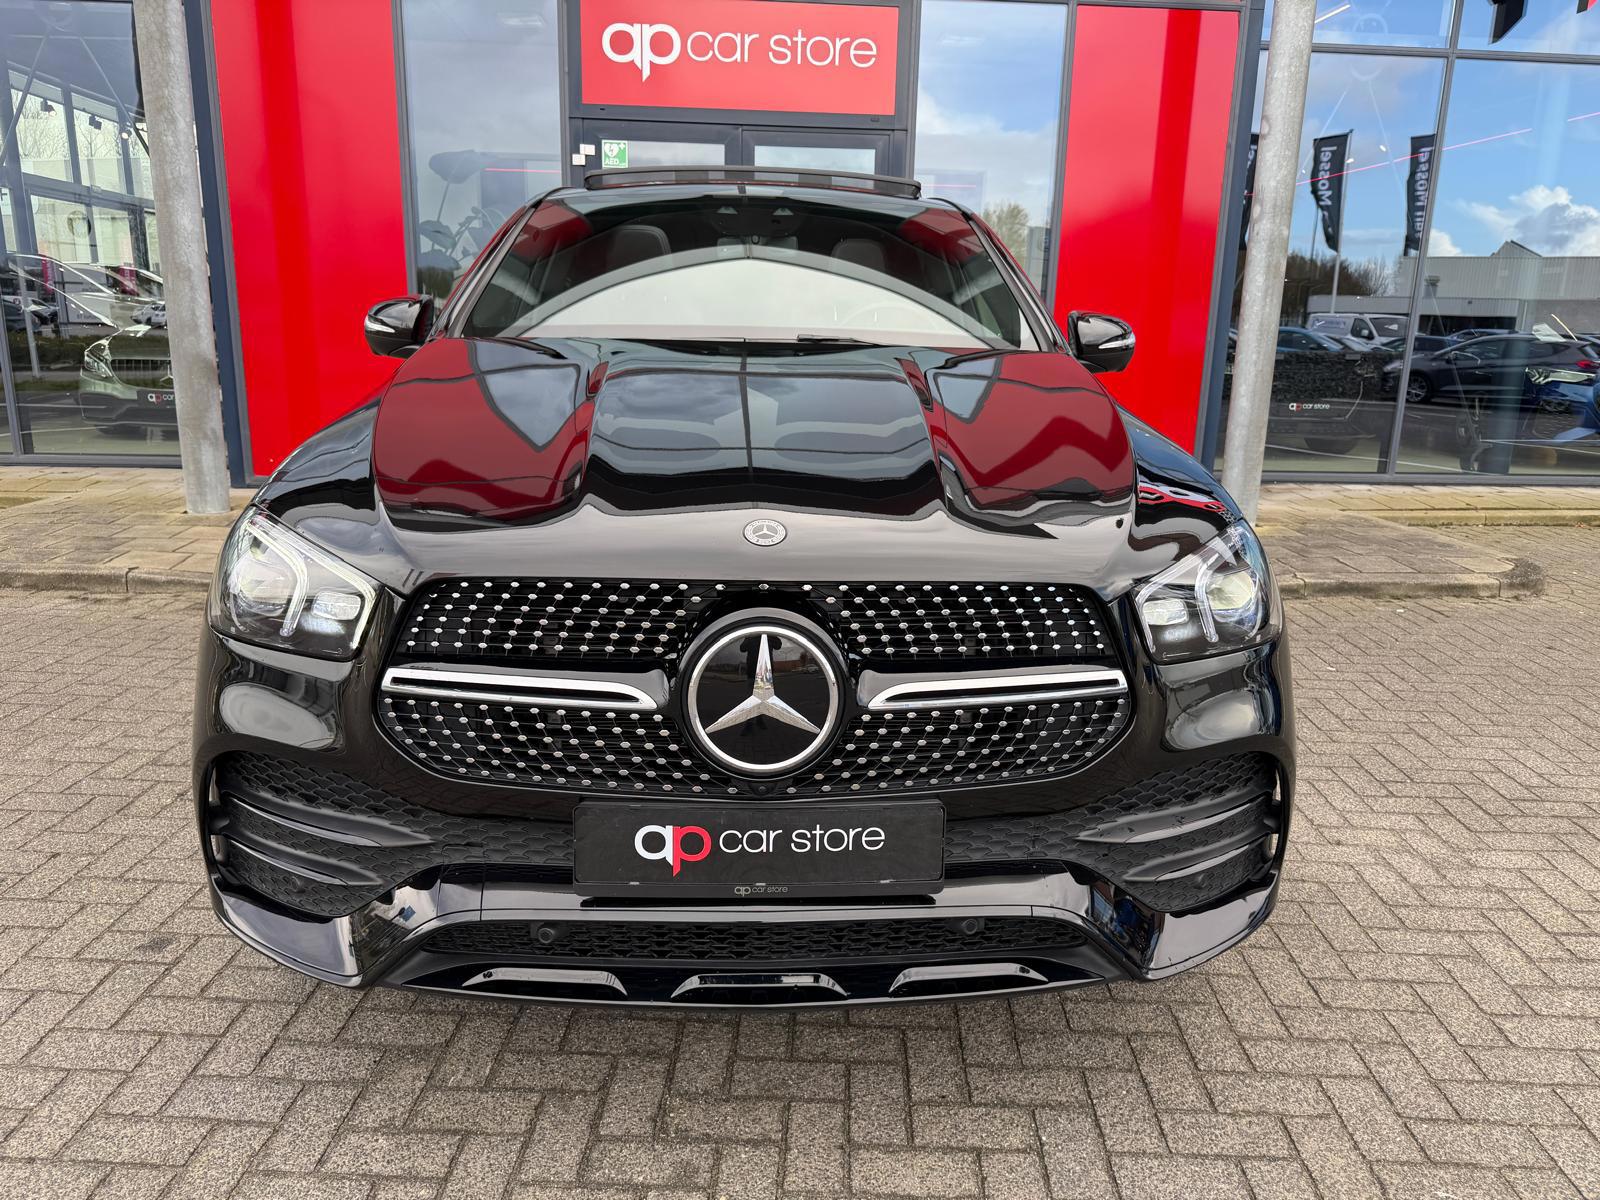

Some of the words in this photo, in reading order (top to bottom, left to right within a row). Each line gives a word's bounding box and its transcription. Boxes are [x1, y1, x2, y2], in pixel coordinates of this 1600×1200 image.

[686, 30, 759, 63] car
[768, 28, 878, 68] store
[719, 829, 783, 853] car
[790, 823, 885, 852] store
[767, 885, 788, 893] store
